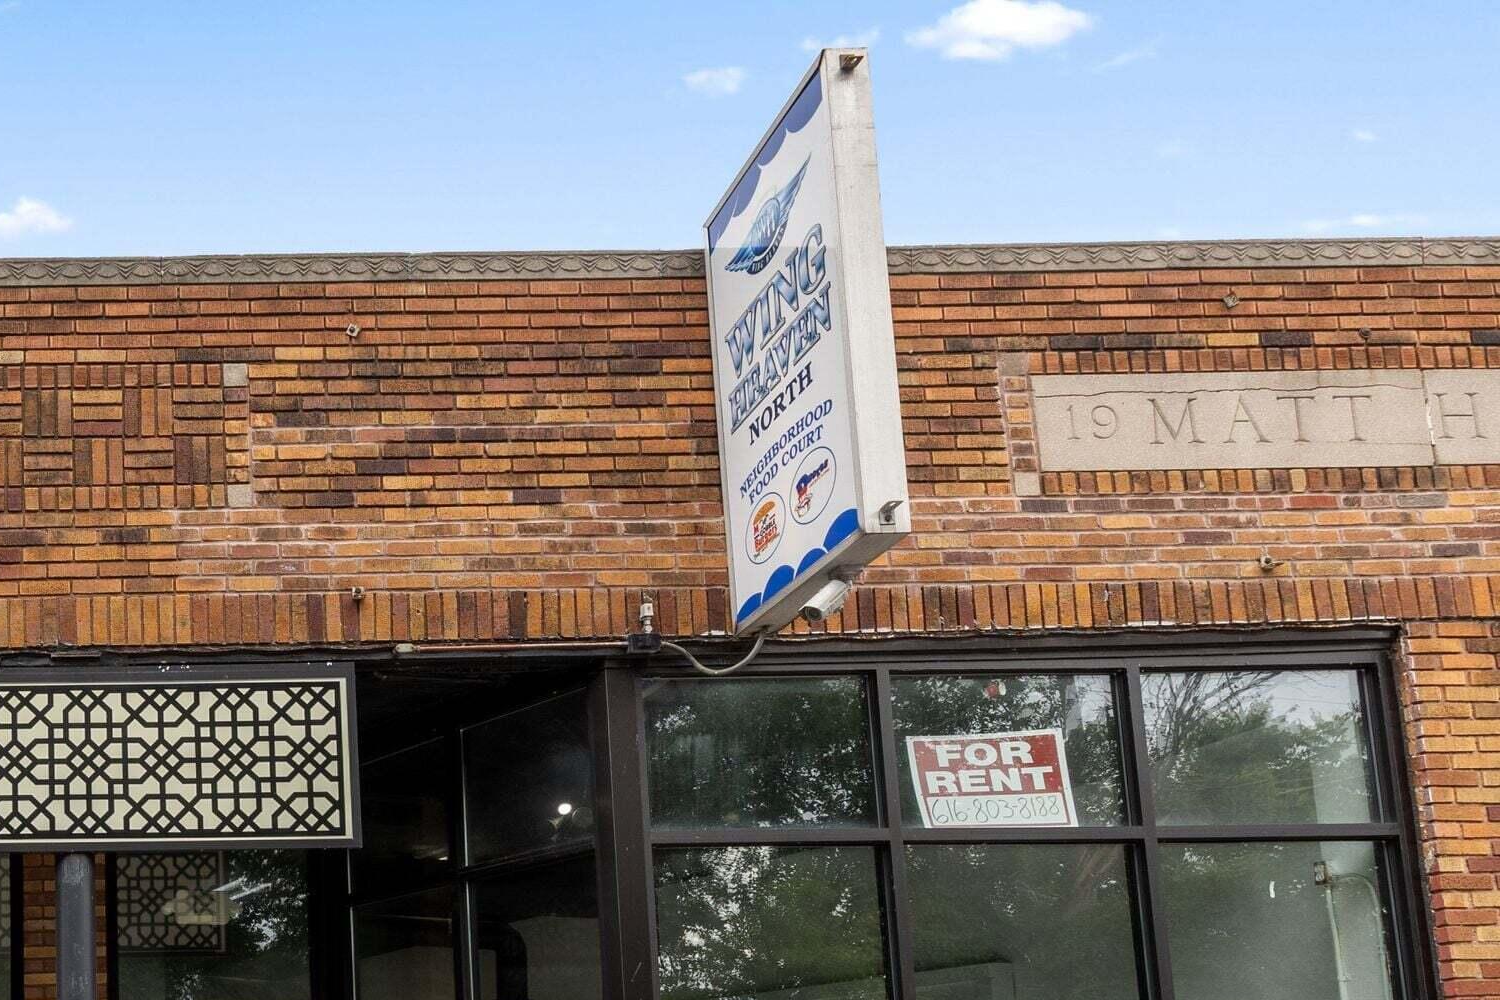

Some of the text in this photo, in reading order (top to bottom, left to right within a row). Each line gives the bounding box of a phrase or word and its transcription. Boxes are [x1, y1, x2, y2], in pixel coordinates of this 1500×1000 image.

[724, 223, 827, 379] WING
[728, 280, 832, 436] HEAVEN
[748, 361, 813, 446] NORTH
[1066, 403, 1119, 441] 19
[1148, 393, 1372, 445] MATT
[740, 399, 833, 498] NEIGHBORHOOD
[749, 464, 779, 506] FOOD
[781, 425, 824, 467] COURT
[925, 765, 1053, 795] RENT
[933, 740, 1034, 769] FOR
[931, 795, 1060, 824] 616-803-8188
